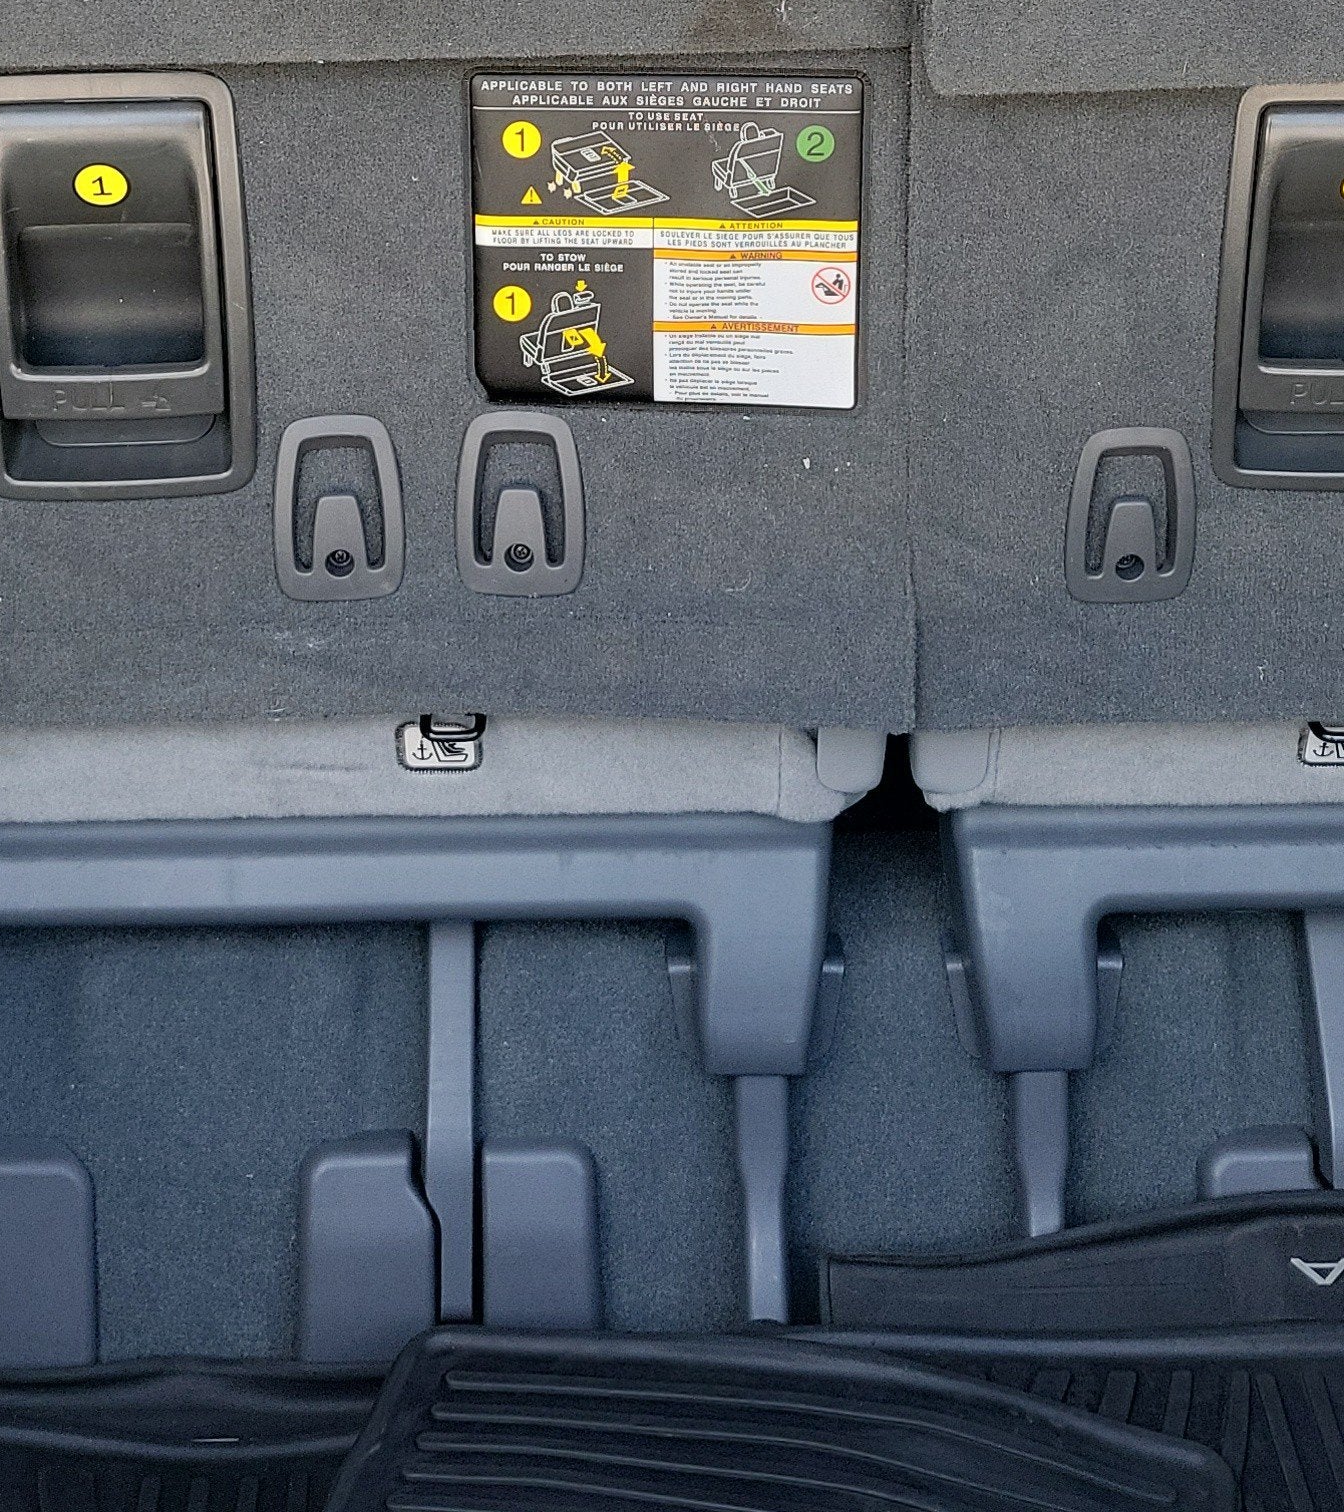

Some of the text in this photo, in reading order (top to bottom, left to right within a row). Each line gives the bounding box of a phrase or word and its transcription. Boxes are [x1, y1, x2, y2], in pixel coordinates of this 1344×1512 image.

[481, 80, 852, 94] APPLICABLE TO BOTH LEFT AND RIGHT HAND SEATS
[512, 94, 821, 108] APPLICABLE AUX SIÈGES GAUCHE ET DROIT
[628, 112, 704, 121] TO USE SEAT
[592, 122, 624, 130] POUR
[629, 122, 682, 131] UTILISER
[687, 123, 700, 131] LE
[514, 129, 527, 152] 1
[806, 132, 825, 156] 2
[92, 176, 112, 196] 1
[540, 253, 586, 262] TO STOW
[503, 263, 530, 271] POUR
[534, 263, 574, 271] RANGER
[579, 264, 591, 272] LE
[505, 293, 516, 316] 1
[722, 323, 799, 332] AVERTISSEMENT
